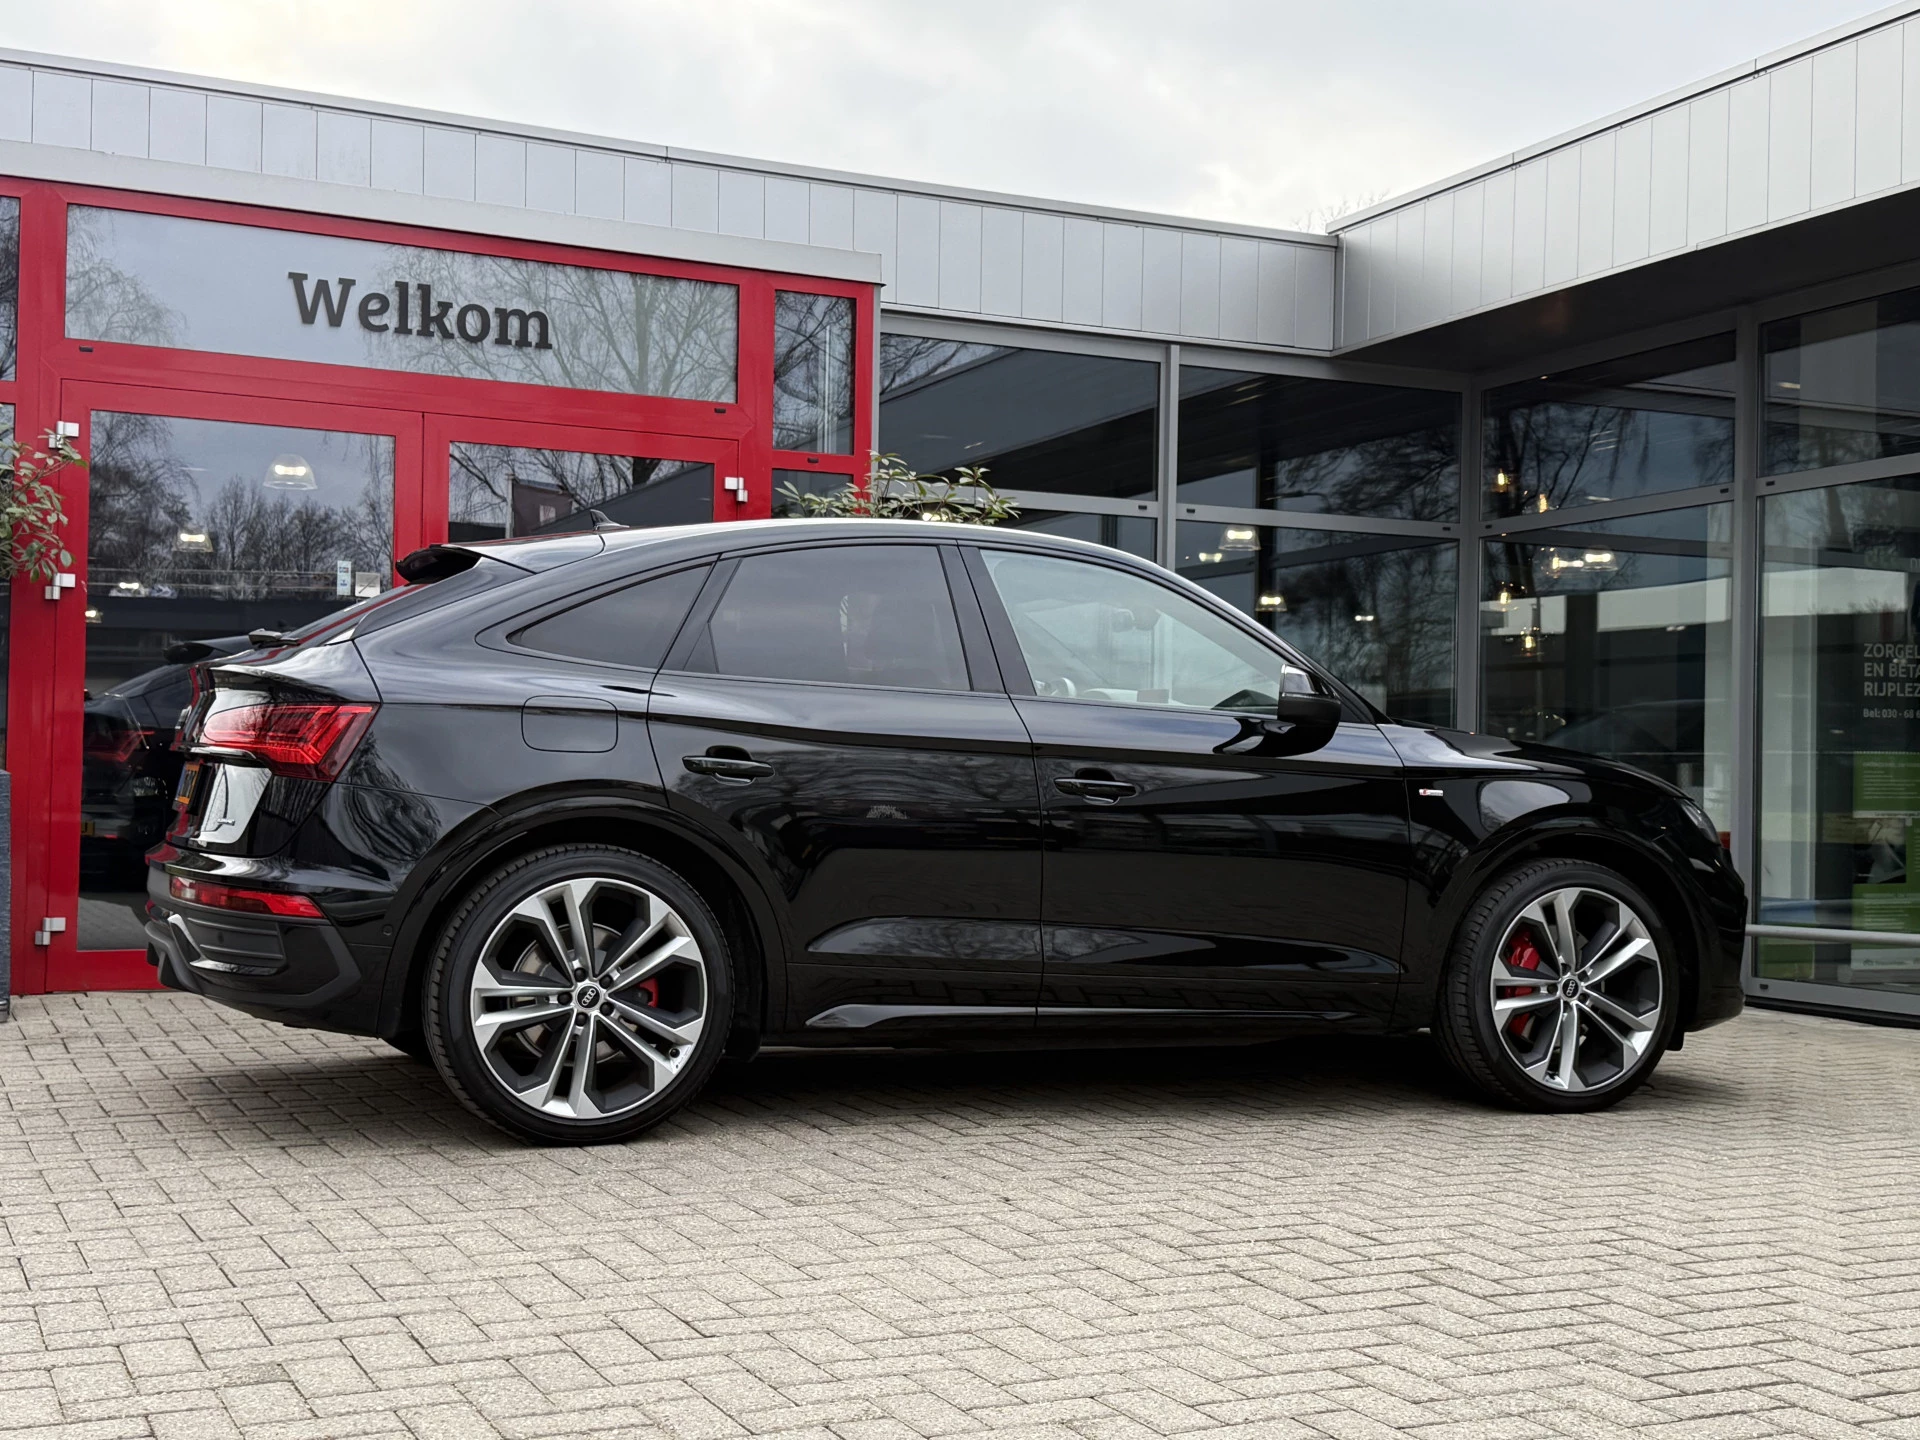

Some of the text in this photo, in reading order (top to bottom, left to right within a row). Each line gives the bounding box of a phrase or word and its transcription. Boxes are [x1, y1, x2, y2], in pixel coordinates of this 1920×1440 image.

[288, 271, 553, 350] Welkom
[1863, 662, 1884, 677] EN
[1882, 708, 1898, 719] 030
